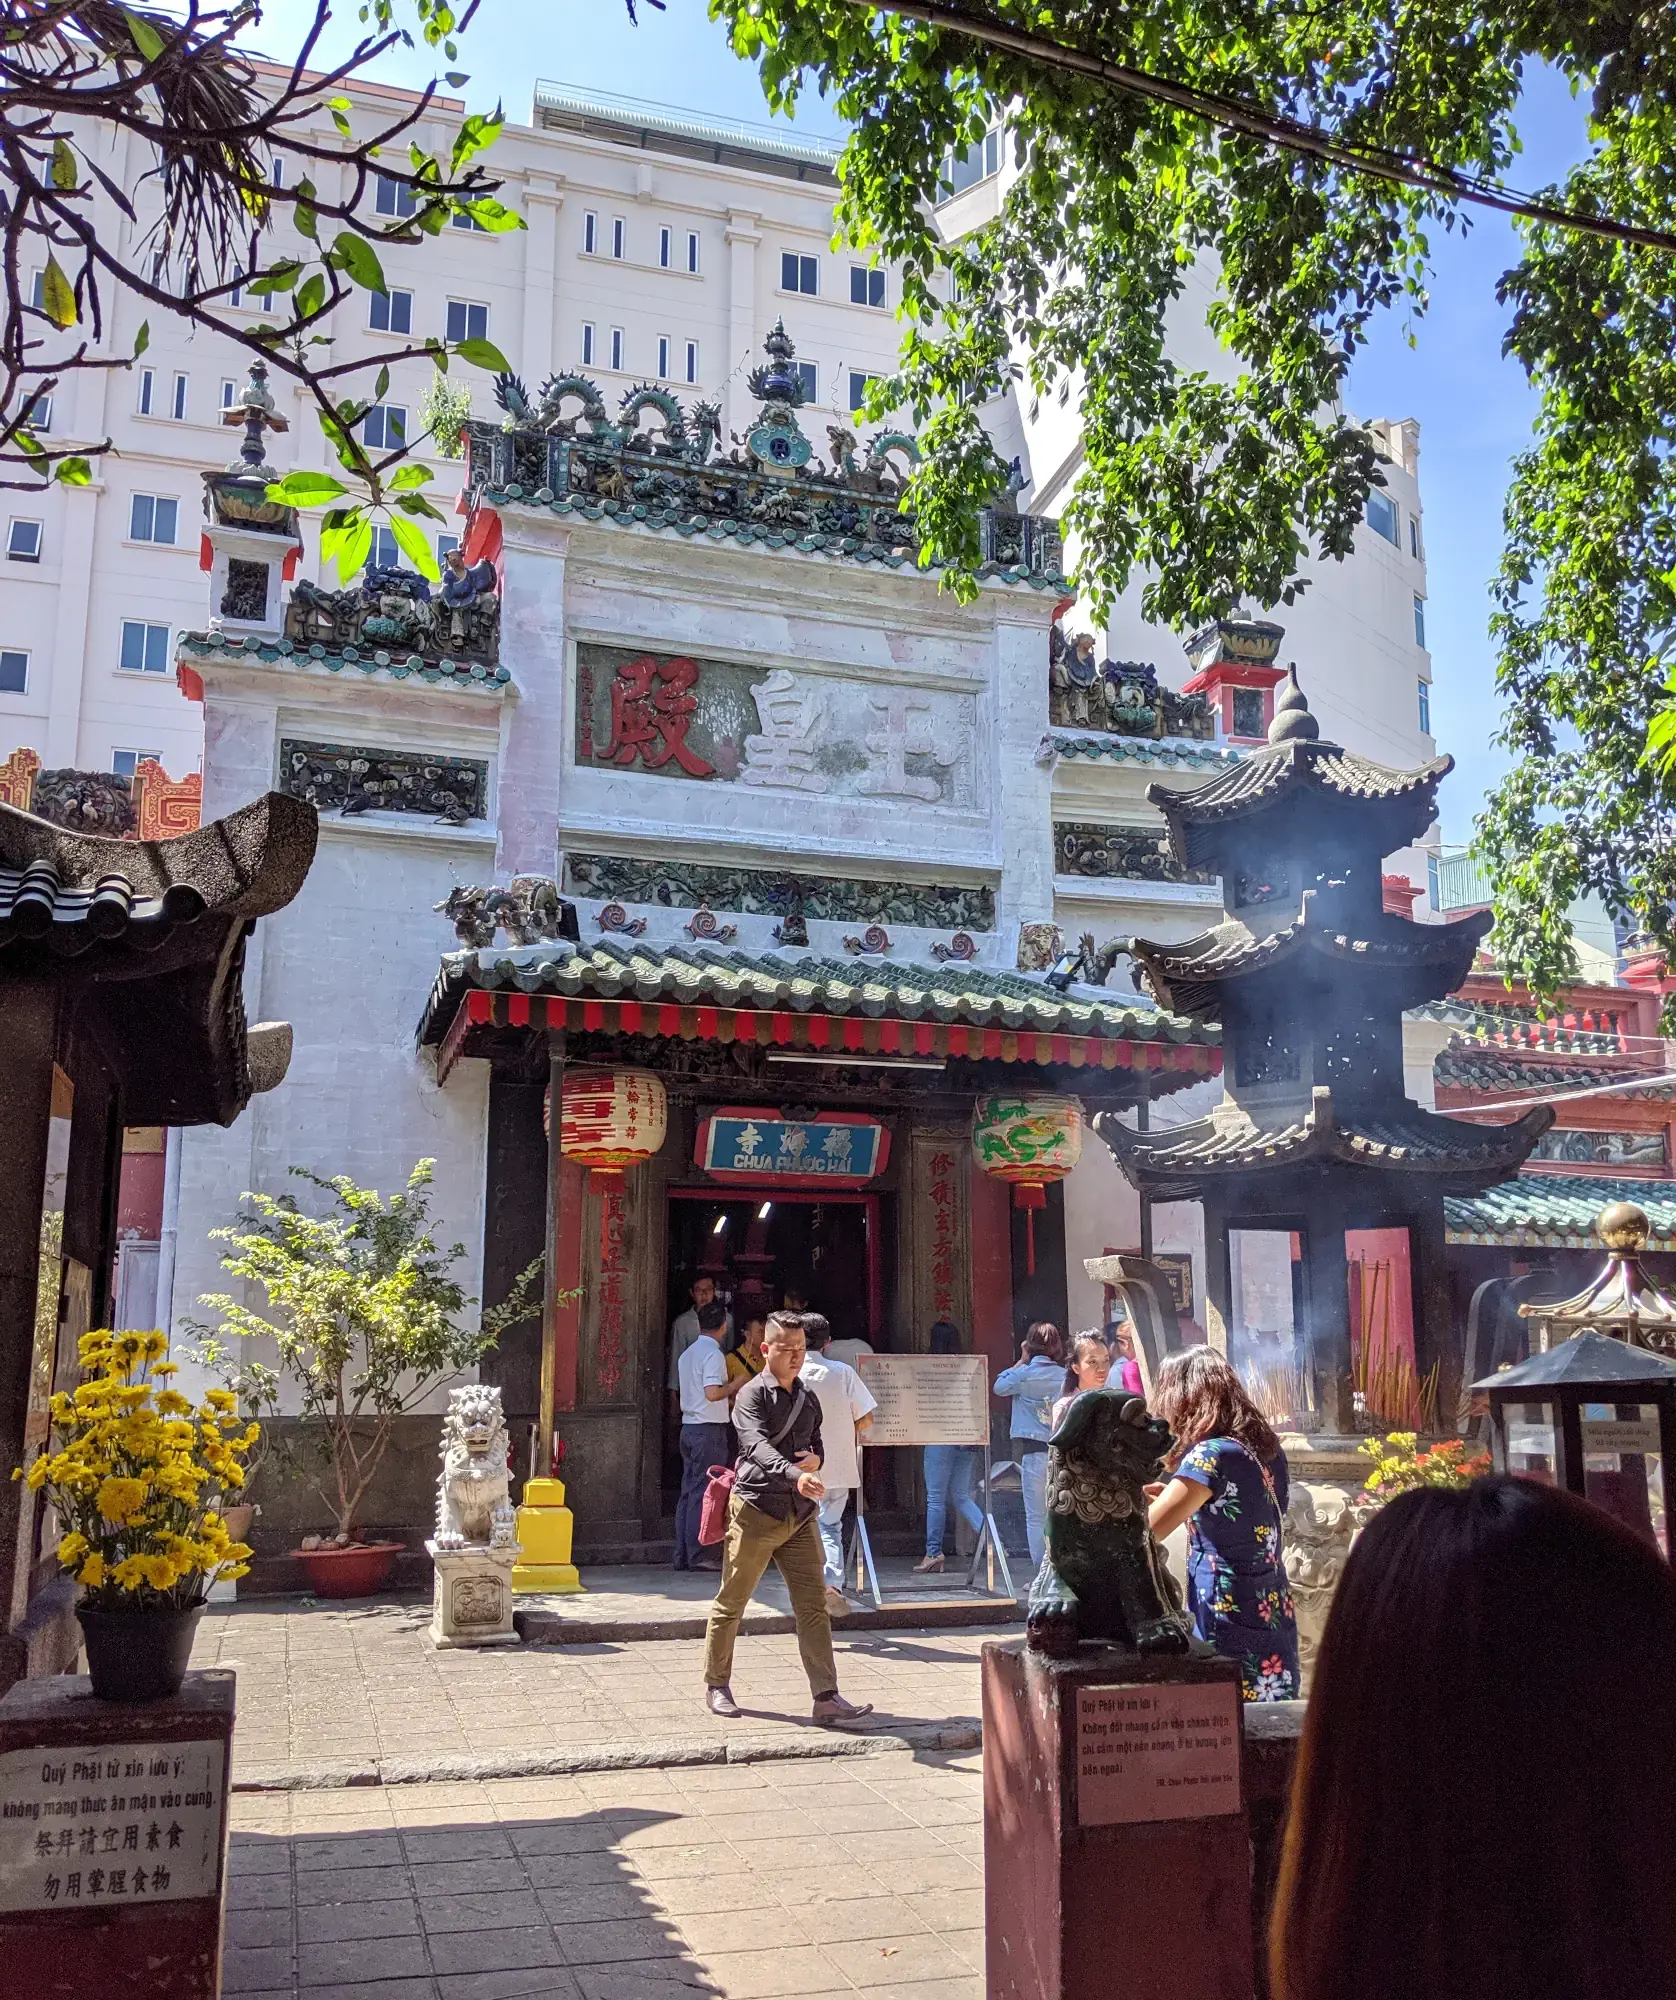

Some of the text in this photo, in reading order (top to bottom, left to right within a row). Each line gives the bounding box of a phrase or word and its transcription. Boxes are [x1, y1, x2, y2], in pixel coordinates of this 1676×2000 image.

[72, 1761, 102, 1784] Phật
[124, 1758, 144, 1779] xin
[43, 1800, 78, 1819] mang
[160, 1790, 182, 1809] vào
